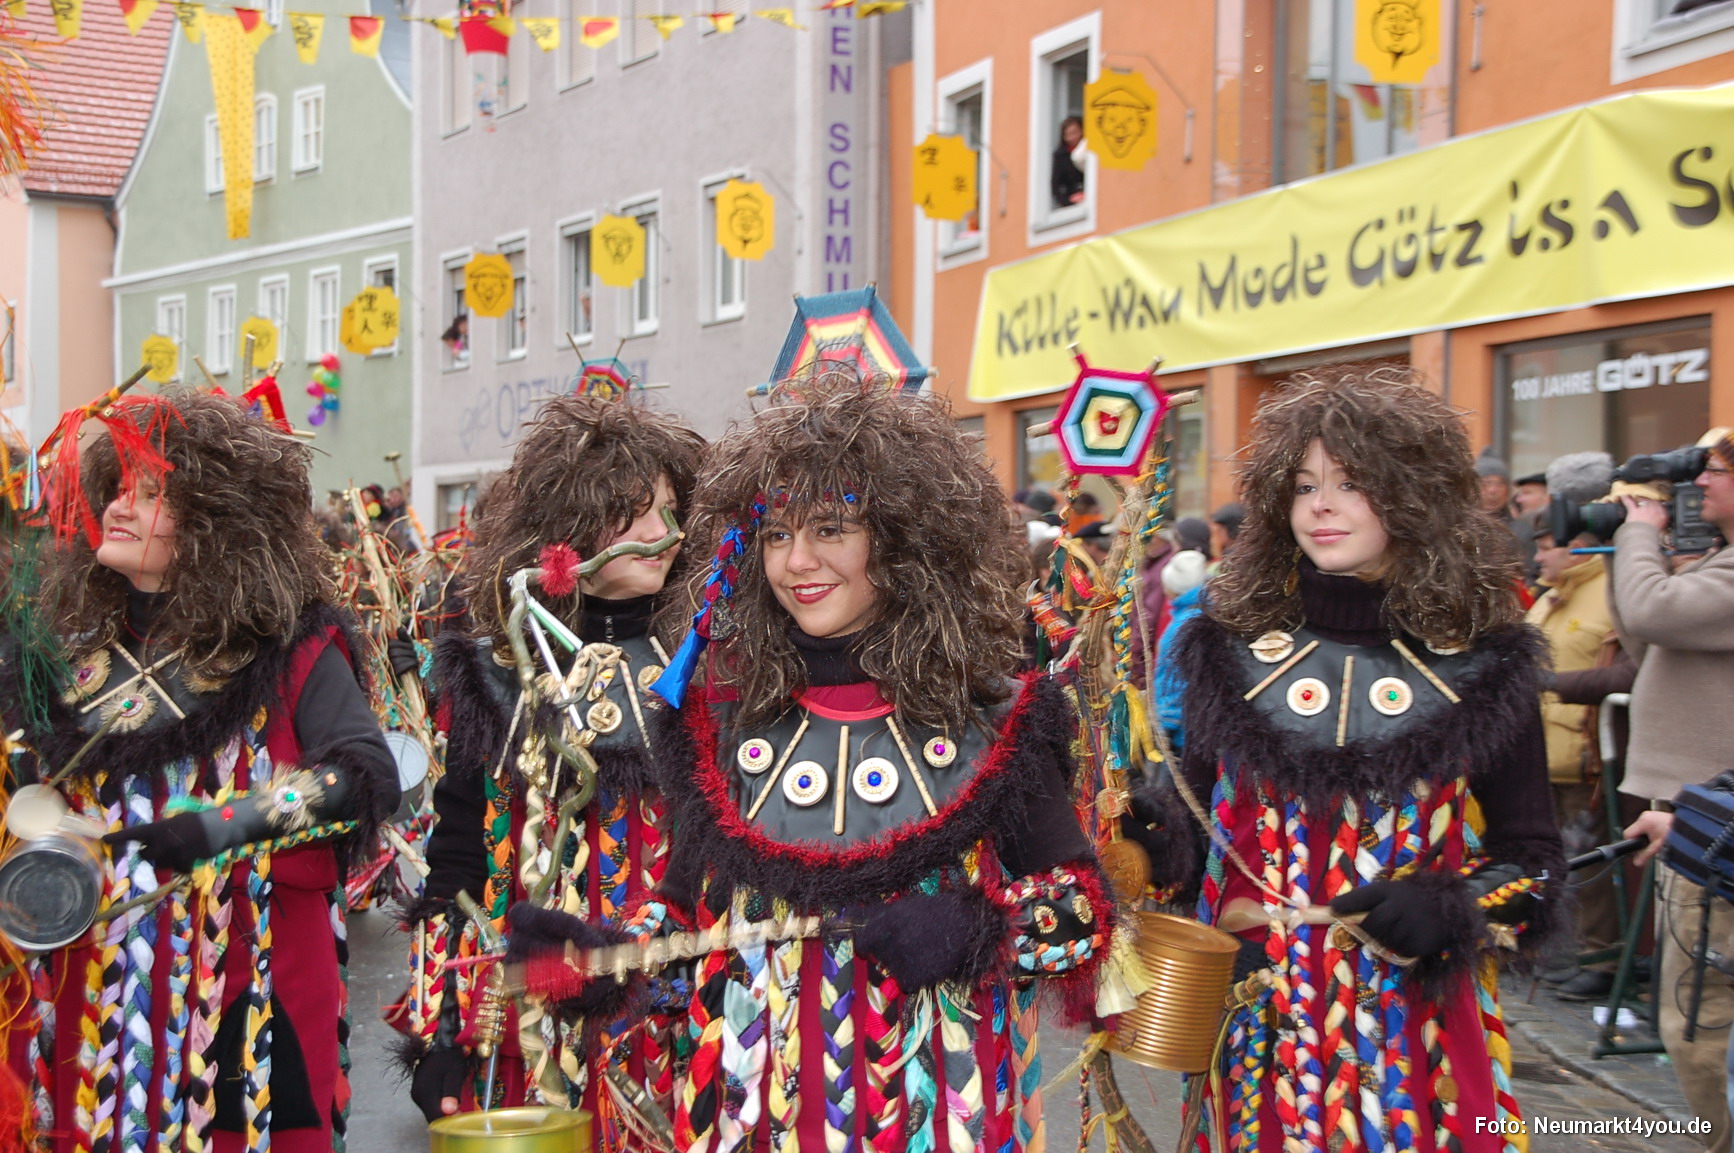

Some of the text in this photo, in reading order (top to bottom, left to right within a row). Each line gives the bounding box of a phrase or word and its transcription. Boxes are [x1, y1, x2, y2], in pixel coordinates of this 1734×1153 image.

[1197, 234, 1328, 316] Mode
[1348, 205, 1485, 288] Götz
[1511, 347, 1710, 401] 100 JAHRE GÖTZ
